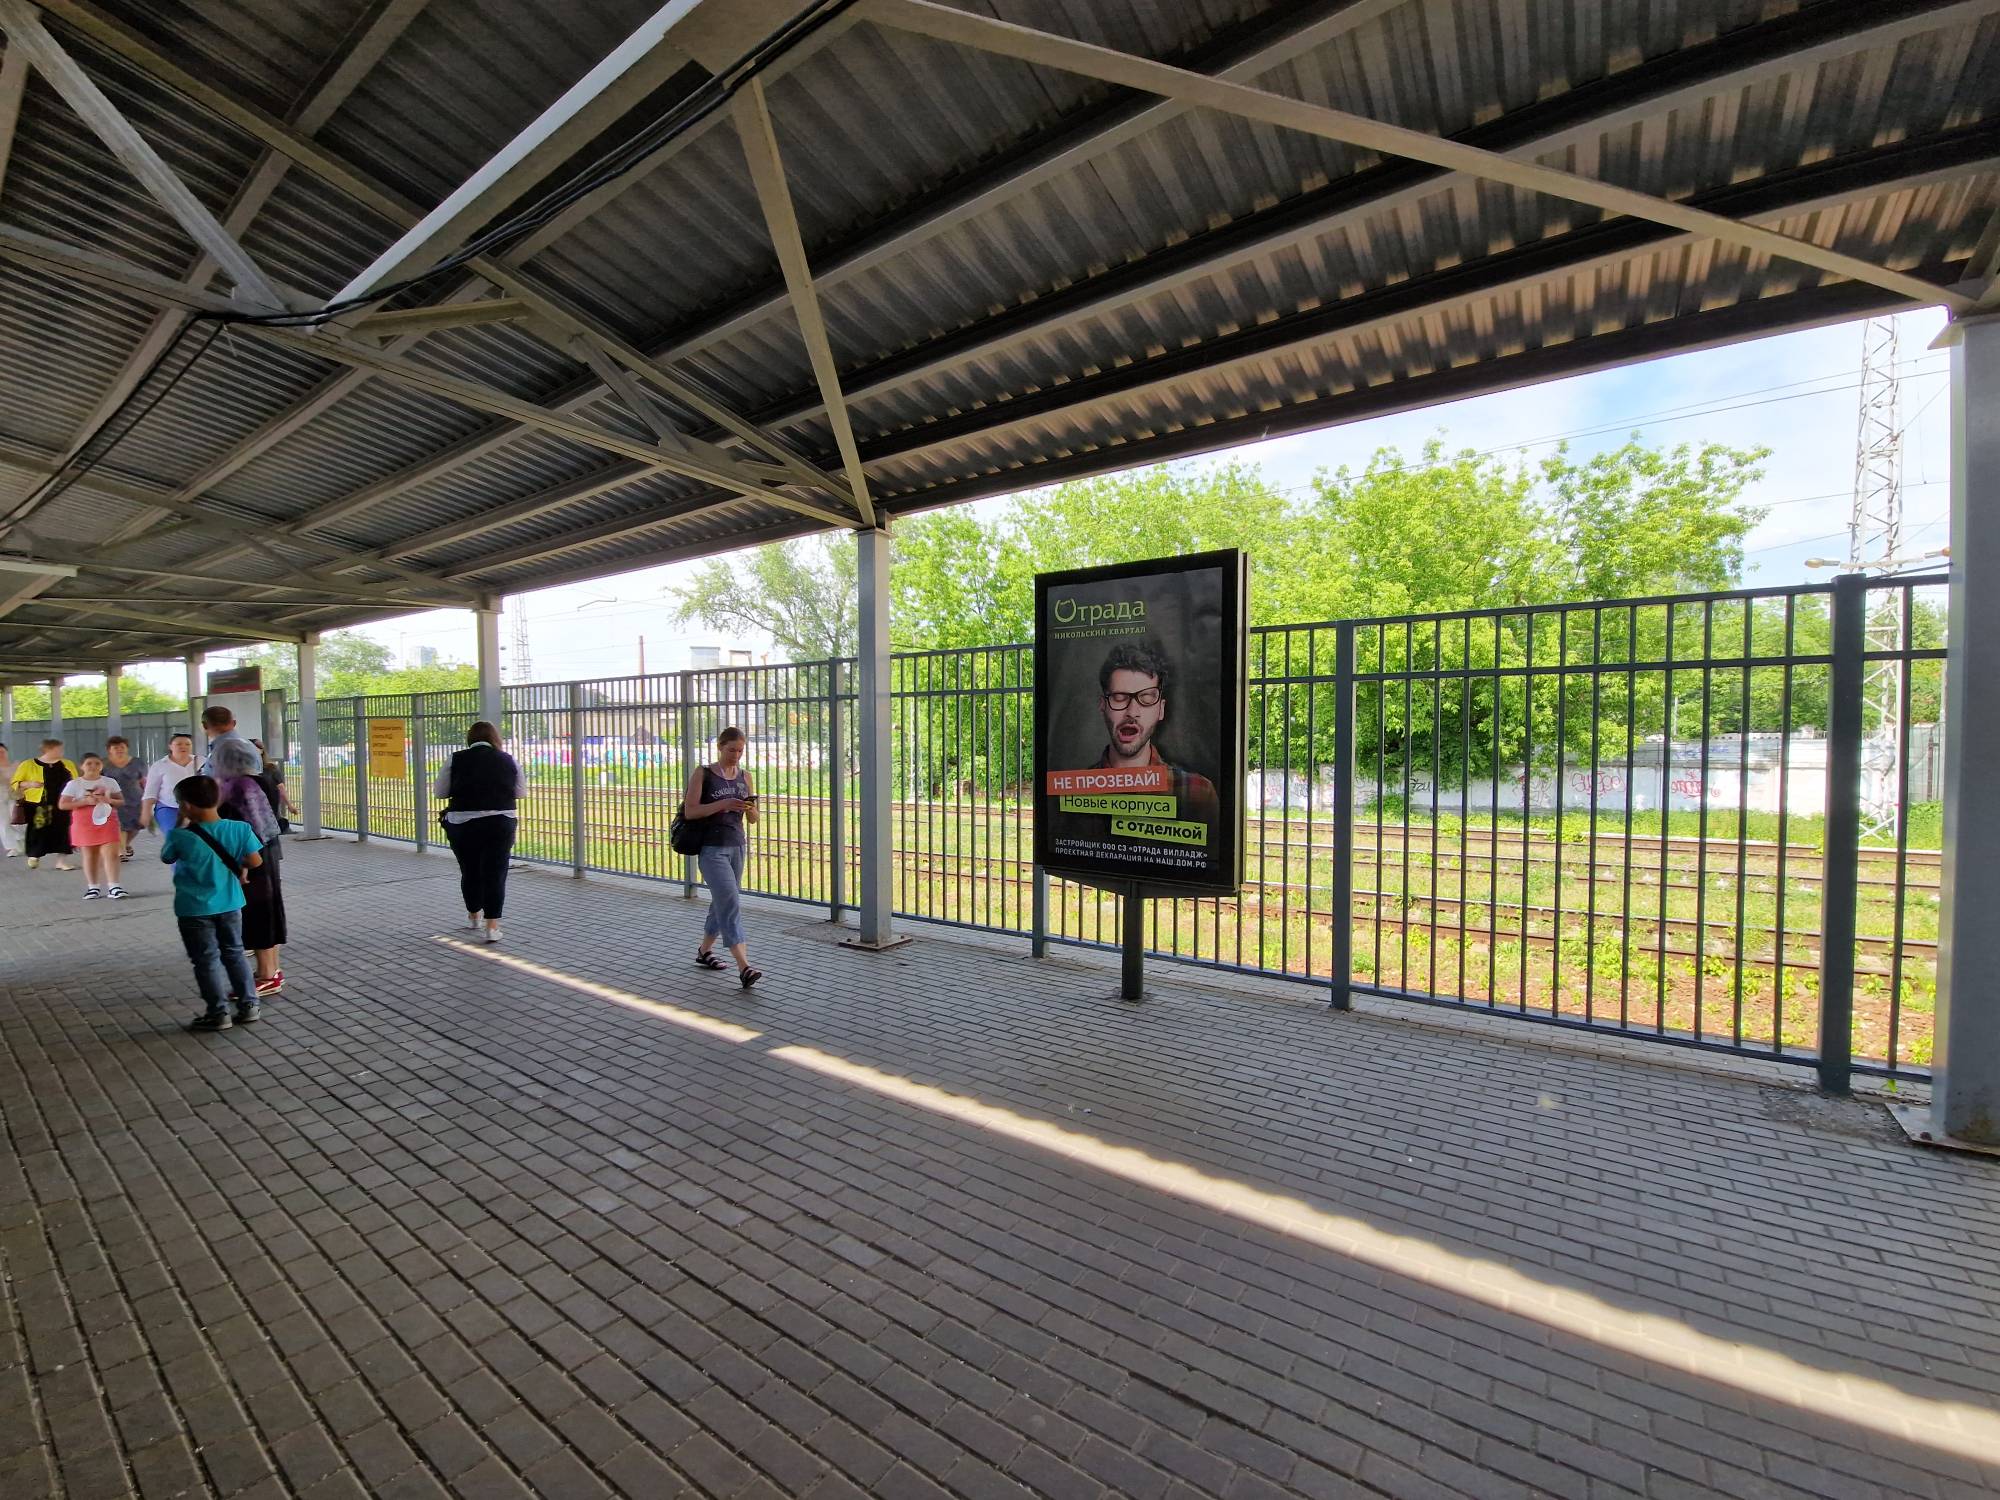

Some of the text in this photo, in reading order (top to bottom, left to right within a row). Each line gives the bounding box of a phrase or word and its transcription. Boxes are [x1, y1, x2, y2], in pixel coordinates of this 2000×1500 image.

[1055, 598, 1145, 626] Отрада
[1054, 626, 1146, 639] НИКОЛЬСКИЙ КВАРТАЛ
[1054, 770, 1160, 789] НЕ ПРОЗЕВАЙ!
[1064, 795, 1170, 814] Новые корпуса
[1116, 820, 1202, 840] с отделкой
[1055, 838, 1101, 849] ЗАСТРОЙЩИК
[1102, 843, 1116, 851] ООО
[1128, 845, 1161, 855] «ОТРАДА
[1163, 848, 1208, 859] ВИЛЛАДЖ»
[1055, 847, 1094, 857] ПРОЕКТНАЯ
[1095, 851, 1142, 862] ДЕКЛАРАЦИЯ
[1156, 857, 1207, 869] НАШ.ДОМ.РФ
